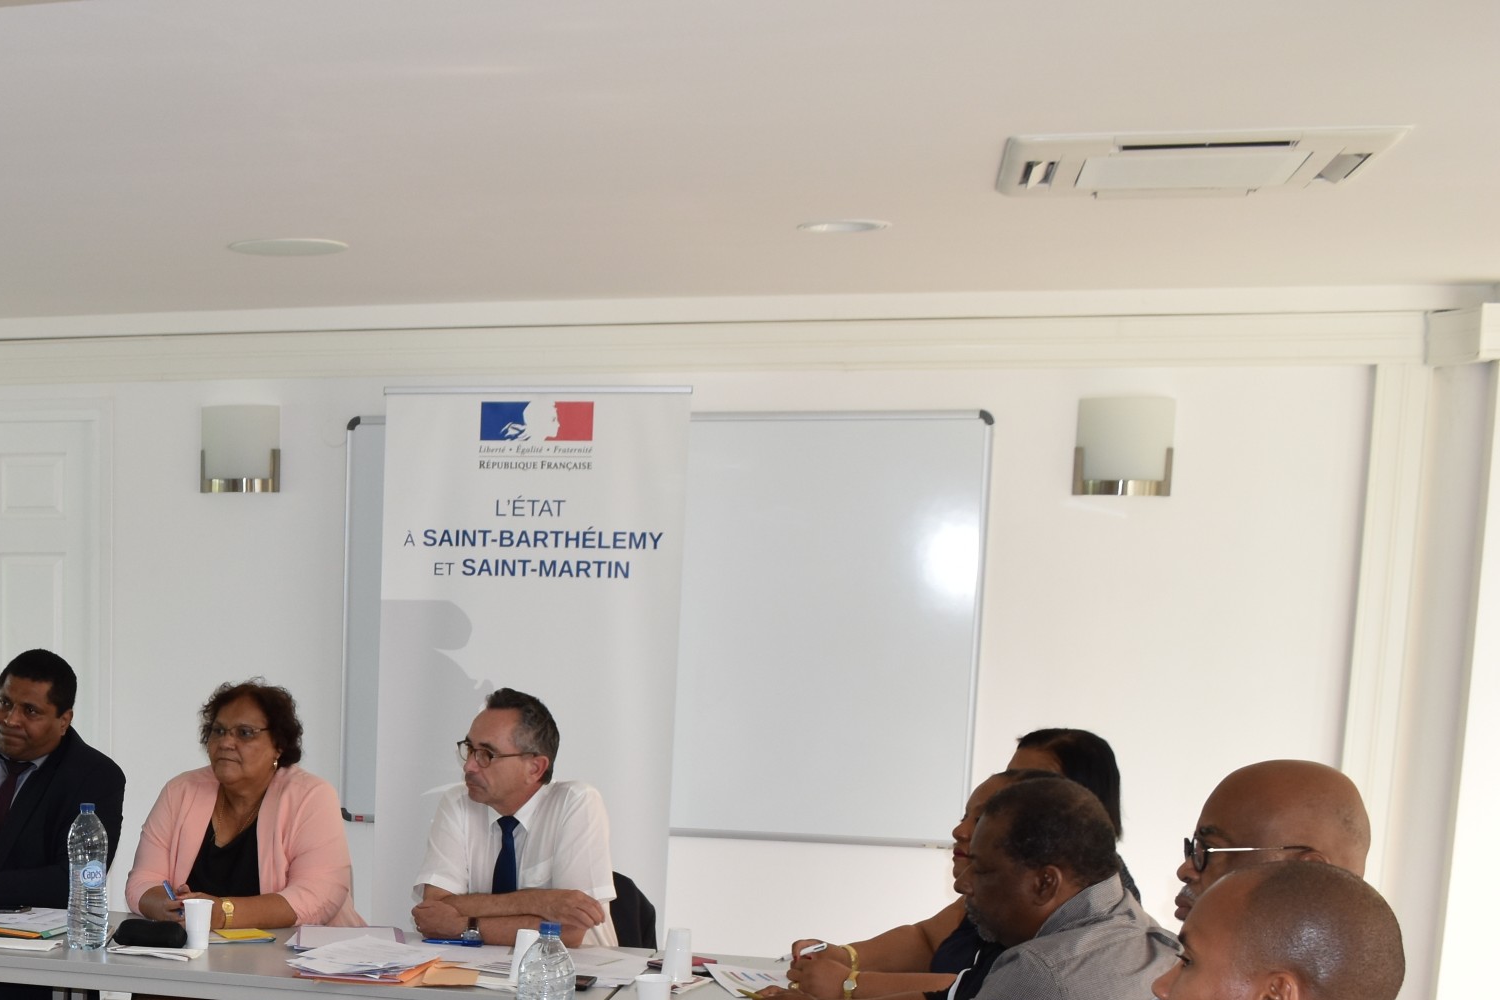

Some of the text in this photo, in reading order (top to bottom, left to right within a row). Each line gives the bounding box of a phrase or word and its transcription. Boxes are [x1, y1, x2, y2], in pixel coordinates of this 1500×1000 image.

[478, 460, 593, 471] RÉPUBLIQUE FRANÇAISE
[495, 495, 566, 517] L'ÉTAT
[403, 526, 664, 550] À SAINT-BARTHÉLEMY
[433, 558, 630, 579] ET SAINT-MARTIN
